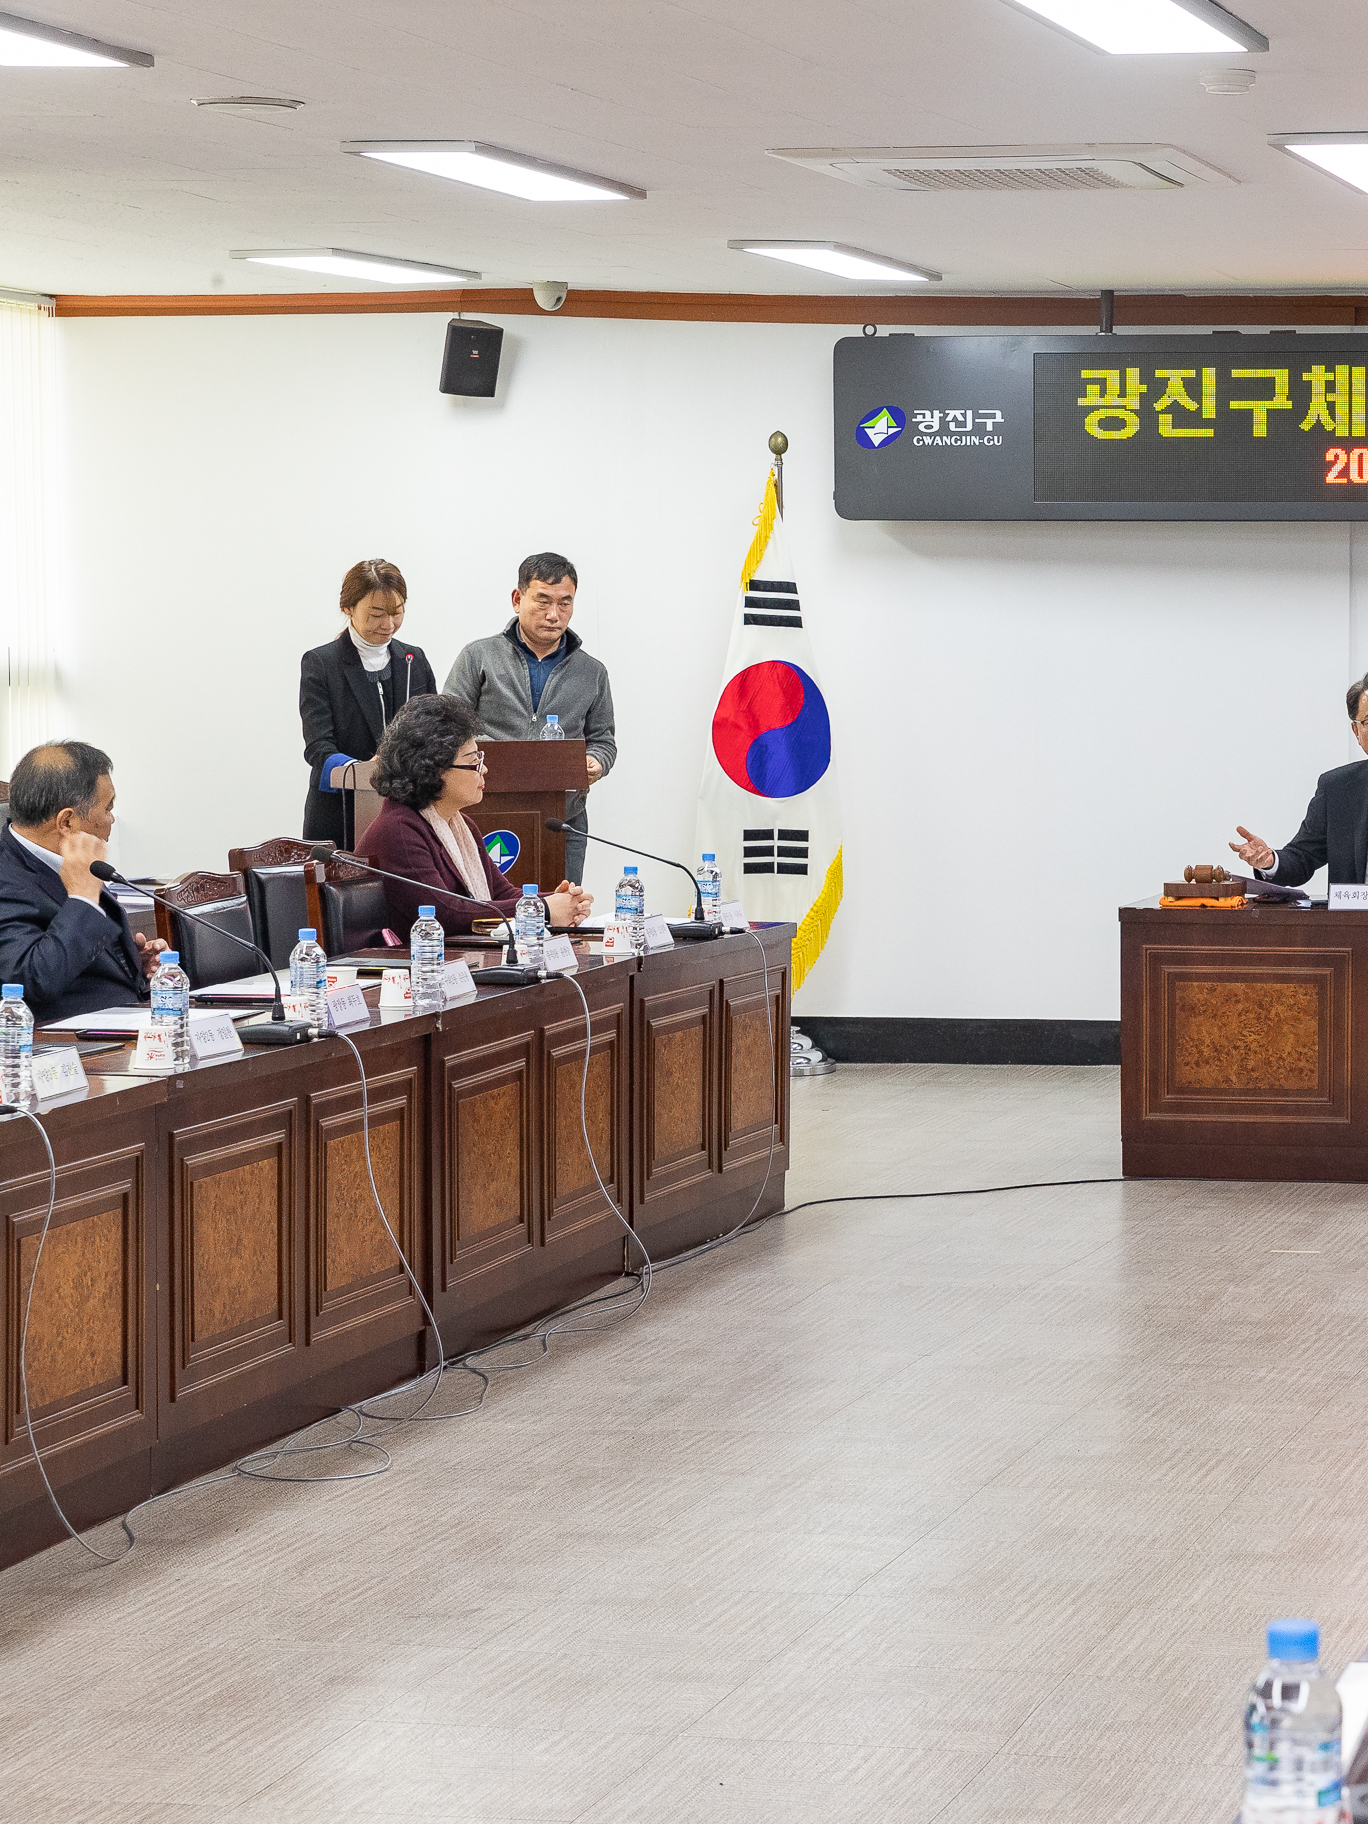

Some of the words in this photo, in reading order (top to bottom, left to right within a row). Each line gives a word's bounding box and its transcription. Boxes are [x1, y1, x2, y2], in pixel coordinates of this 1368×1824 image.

[911, 409, 1005, 433] 광진구
[912, 435, 1003, 447] GWANGJIN-GU
[1333, 890, 1368, 901] 체육회장
